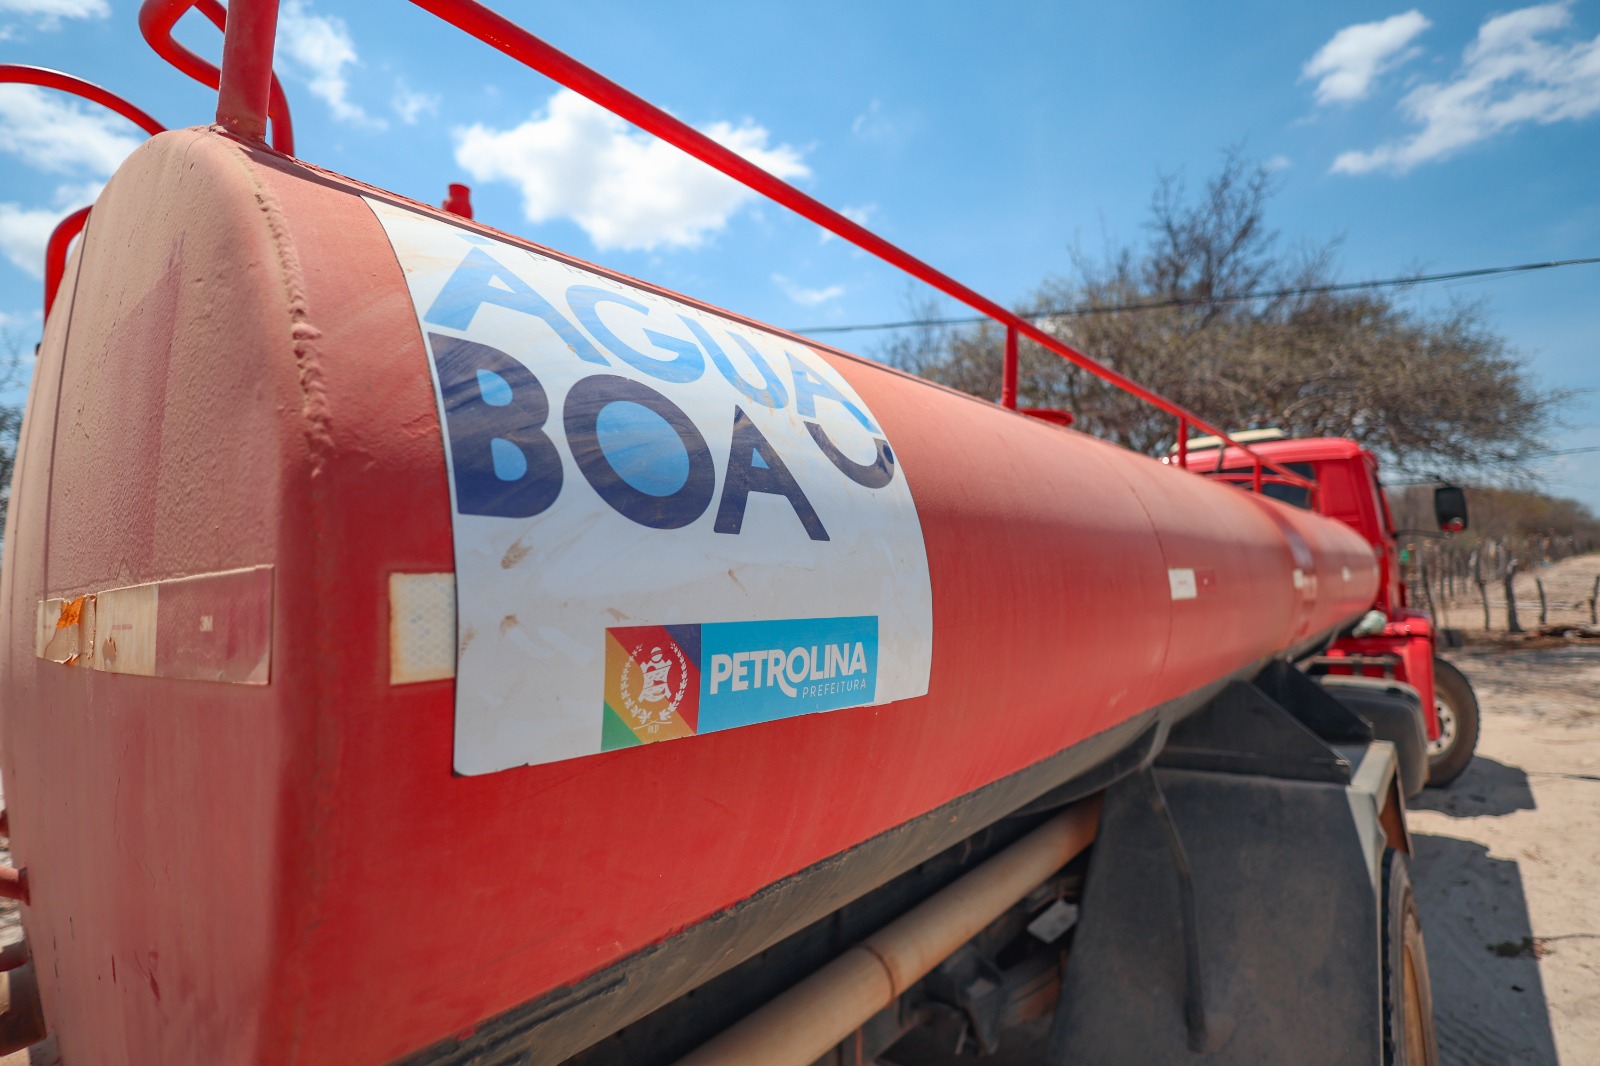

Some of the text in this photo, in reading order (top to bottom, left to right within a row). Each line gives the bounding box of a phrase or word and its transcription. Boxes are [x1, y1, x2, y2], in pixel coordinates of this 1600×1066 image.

[423, 233, 882, 435] ÁGUA
[427, 331, 830, 542] BOA
[200, 615, 213, 632] 3M
[709, 641, 868, 698] PETROLINA
[802, 678, 867, 699] PREFEITURA
